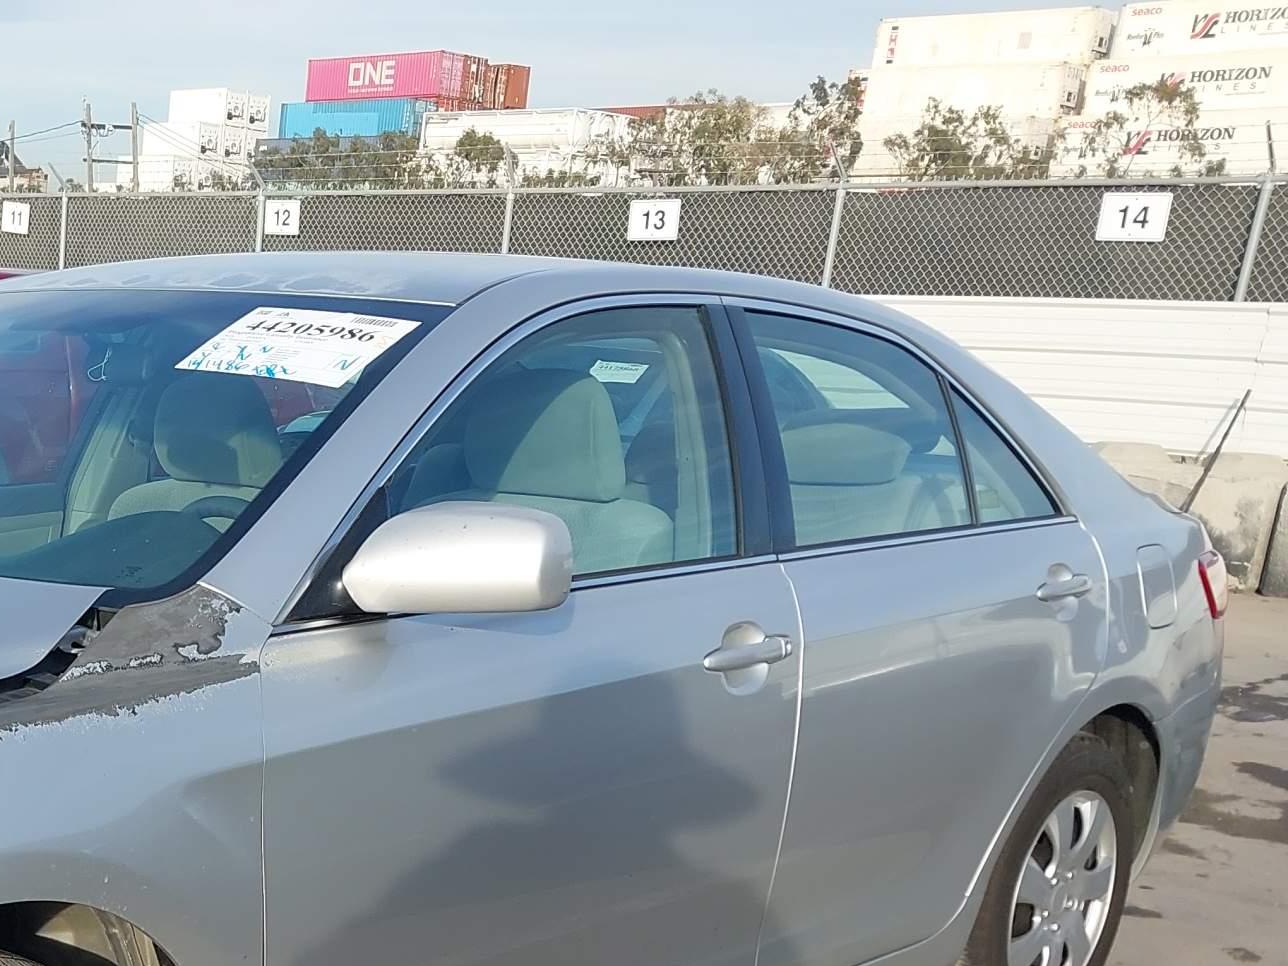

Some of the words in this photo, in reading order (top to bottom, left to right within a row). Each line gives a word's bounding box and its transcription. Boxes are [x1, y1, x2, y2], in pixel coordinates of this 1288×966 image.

[1131, 6, 1163, 17] seaco
[347, 60, 395, 87] ONE
[1100, 63, 1130, 73] seaco
[1189, 66, 1273, 83] HORIZON
[11, 210, 23, 226] 11
[274, 209, 291, 226] 12
[642, 210, 666, 230] 13
[1118, 205, 1149, 229] 14
[245, 319, 380, 343] 44205986
